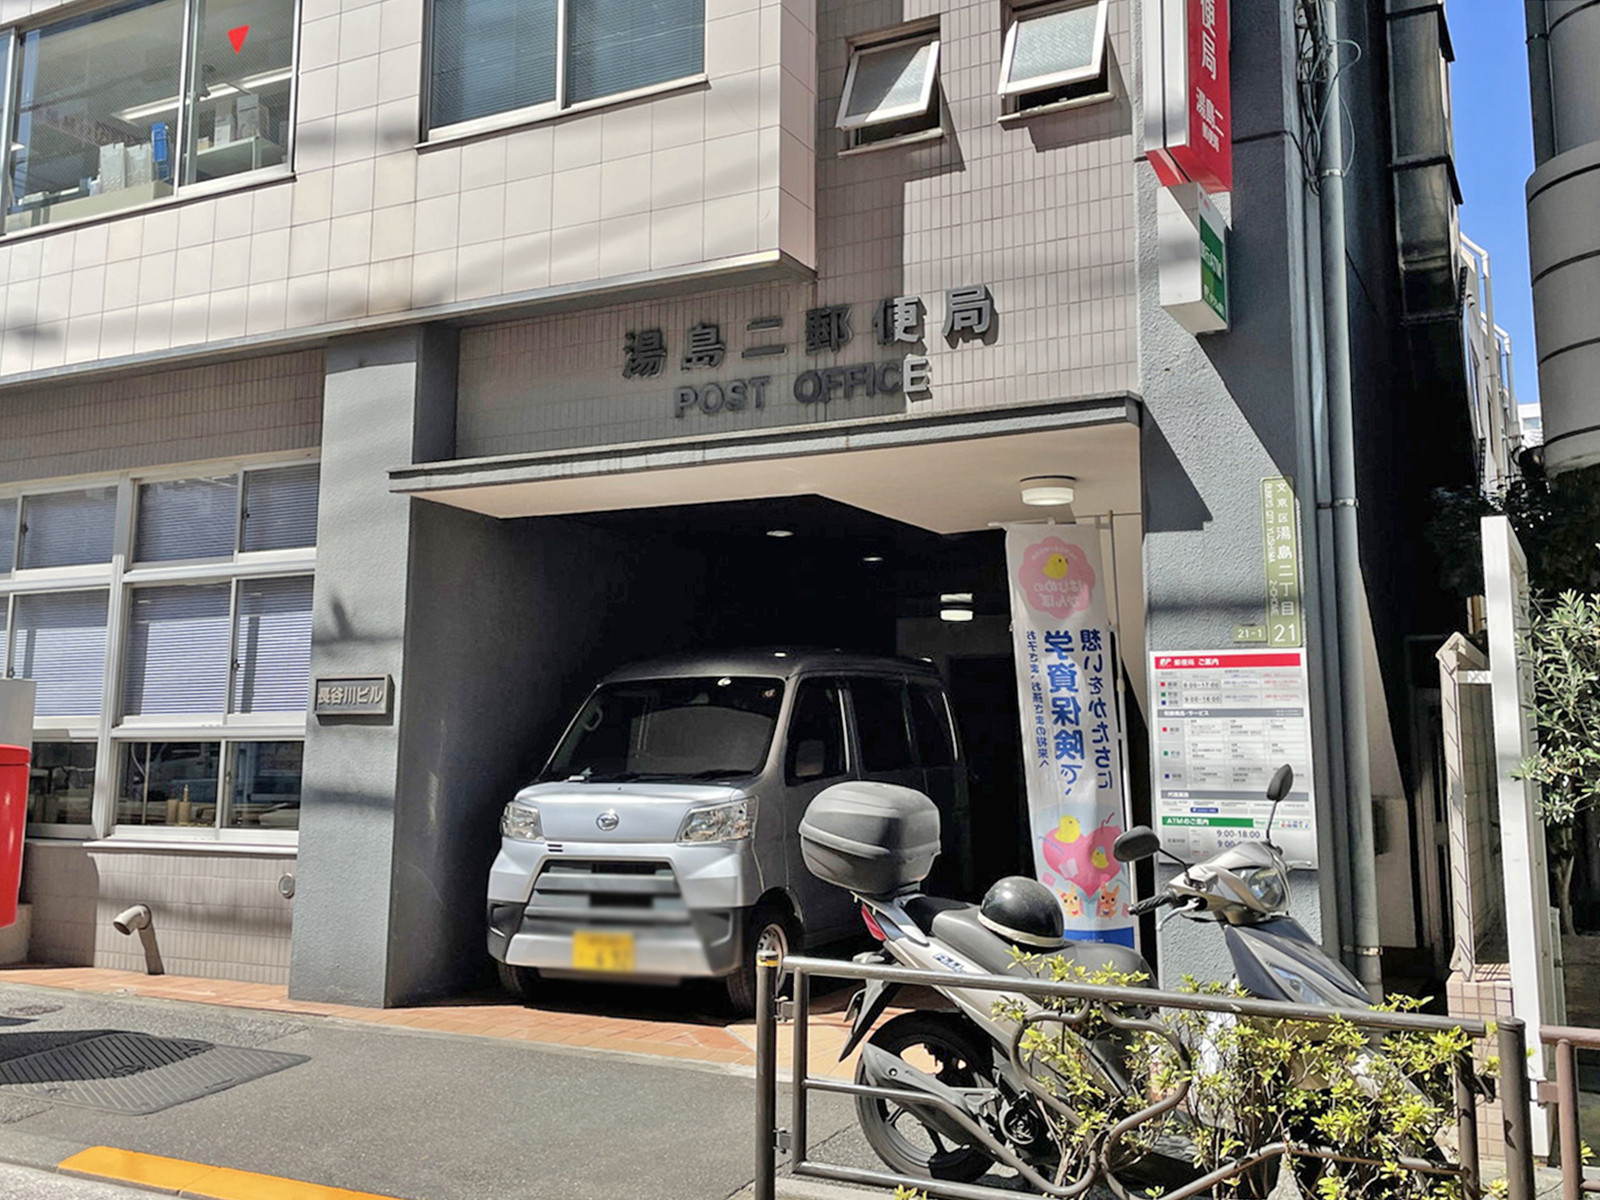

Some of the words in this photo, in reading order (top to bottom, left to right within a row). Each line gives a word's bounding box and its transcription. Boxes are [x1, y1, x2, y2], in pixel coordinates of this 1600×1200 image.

[622, 285, 994, 379] 湯島二郵便局
[675, 376, 771, 418] POST
[793, 355, 930, 405] OFFICE
[1264, 484, 1273, 508] BUNKYO
[1265, 510, 1275, 524] CITY
[1266, 527, 1276, 563] YUSHIMA
[1276, 482, 1294, 617] 文京区湯島二丁目
[1269, 580, 1279, 616] 2-CHOME
[1237, 629, 1262, 638] 21-1
[1274, 624, 1296, 642] 21
[318, 686, 383, 704] 長谷川ビル
[1216, 830, 1261, 839] 9:00-18:00
